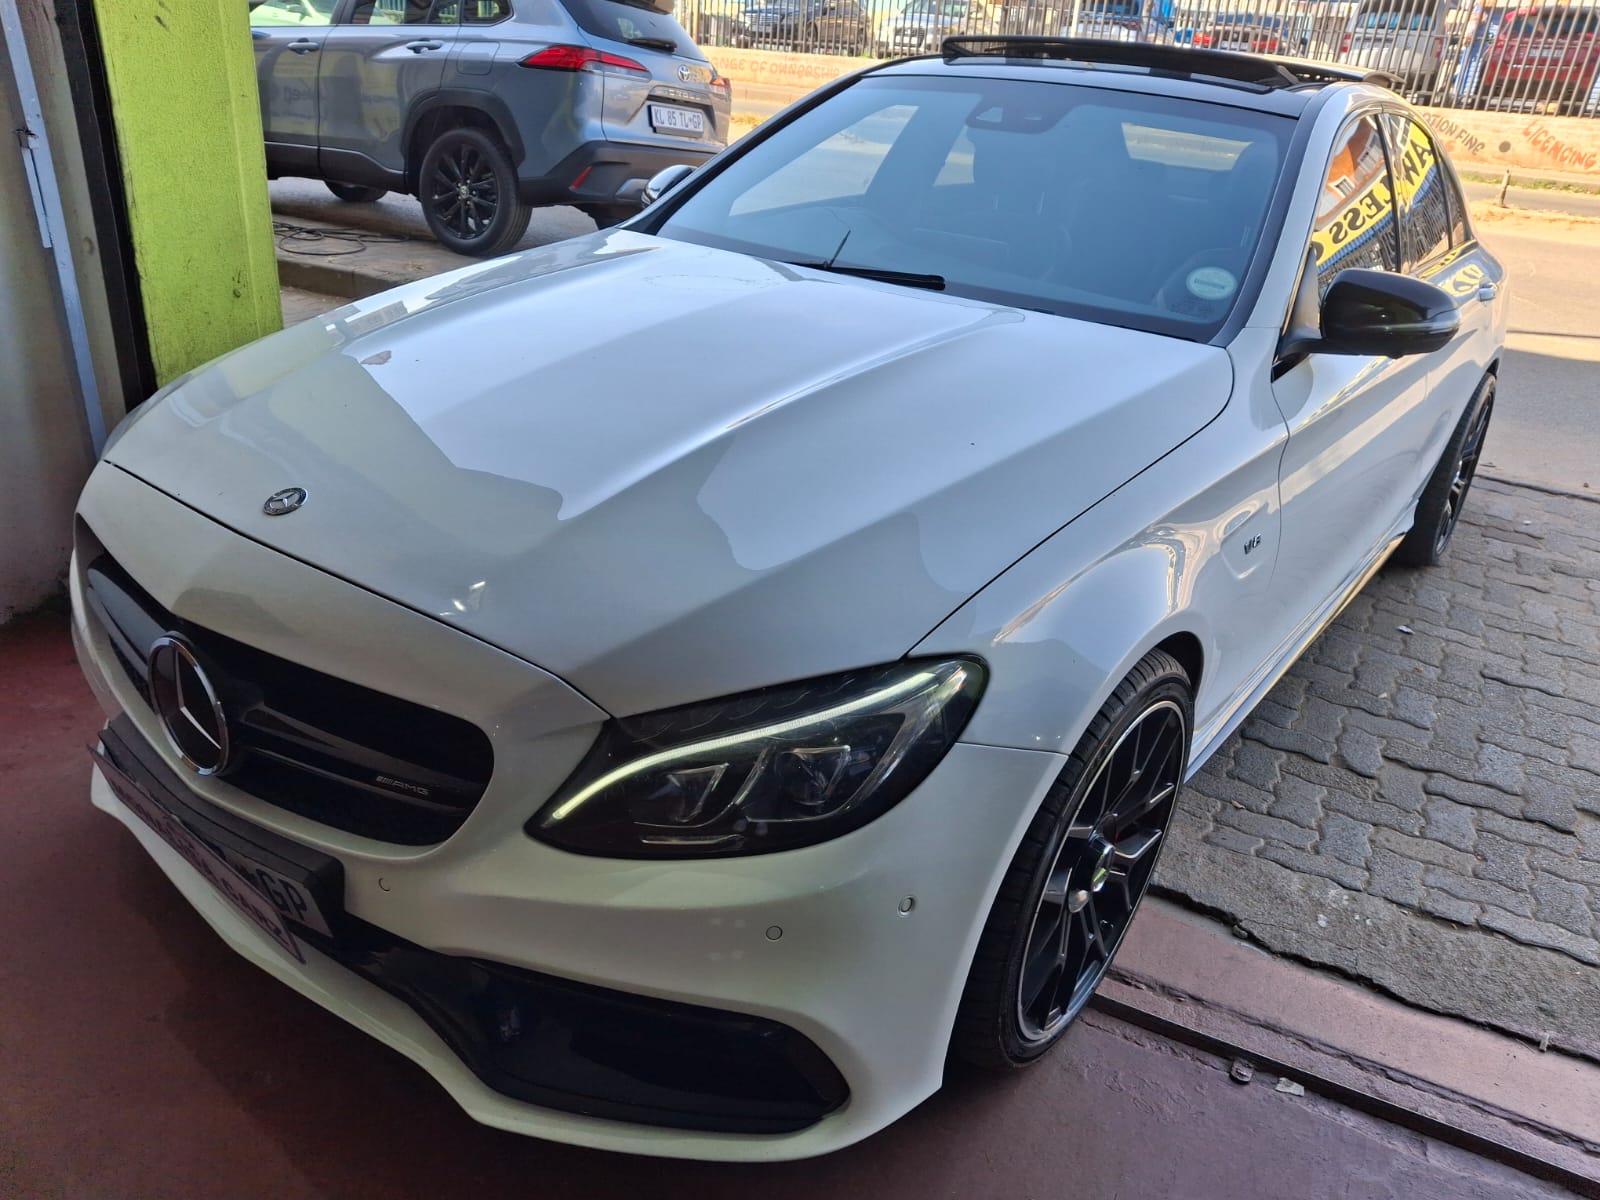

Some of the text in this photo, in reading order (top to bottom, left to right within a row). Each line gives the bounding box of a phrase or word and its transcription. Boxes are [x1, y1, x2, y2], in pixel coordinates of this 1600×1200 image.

[750, 60, 768, 73] OF
[654, 108, 665, 125] KL
[1521, 120, 1597, 170] LICENCING
[388, 778, 429, 796] AMG
